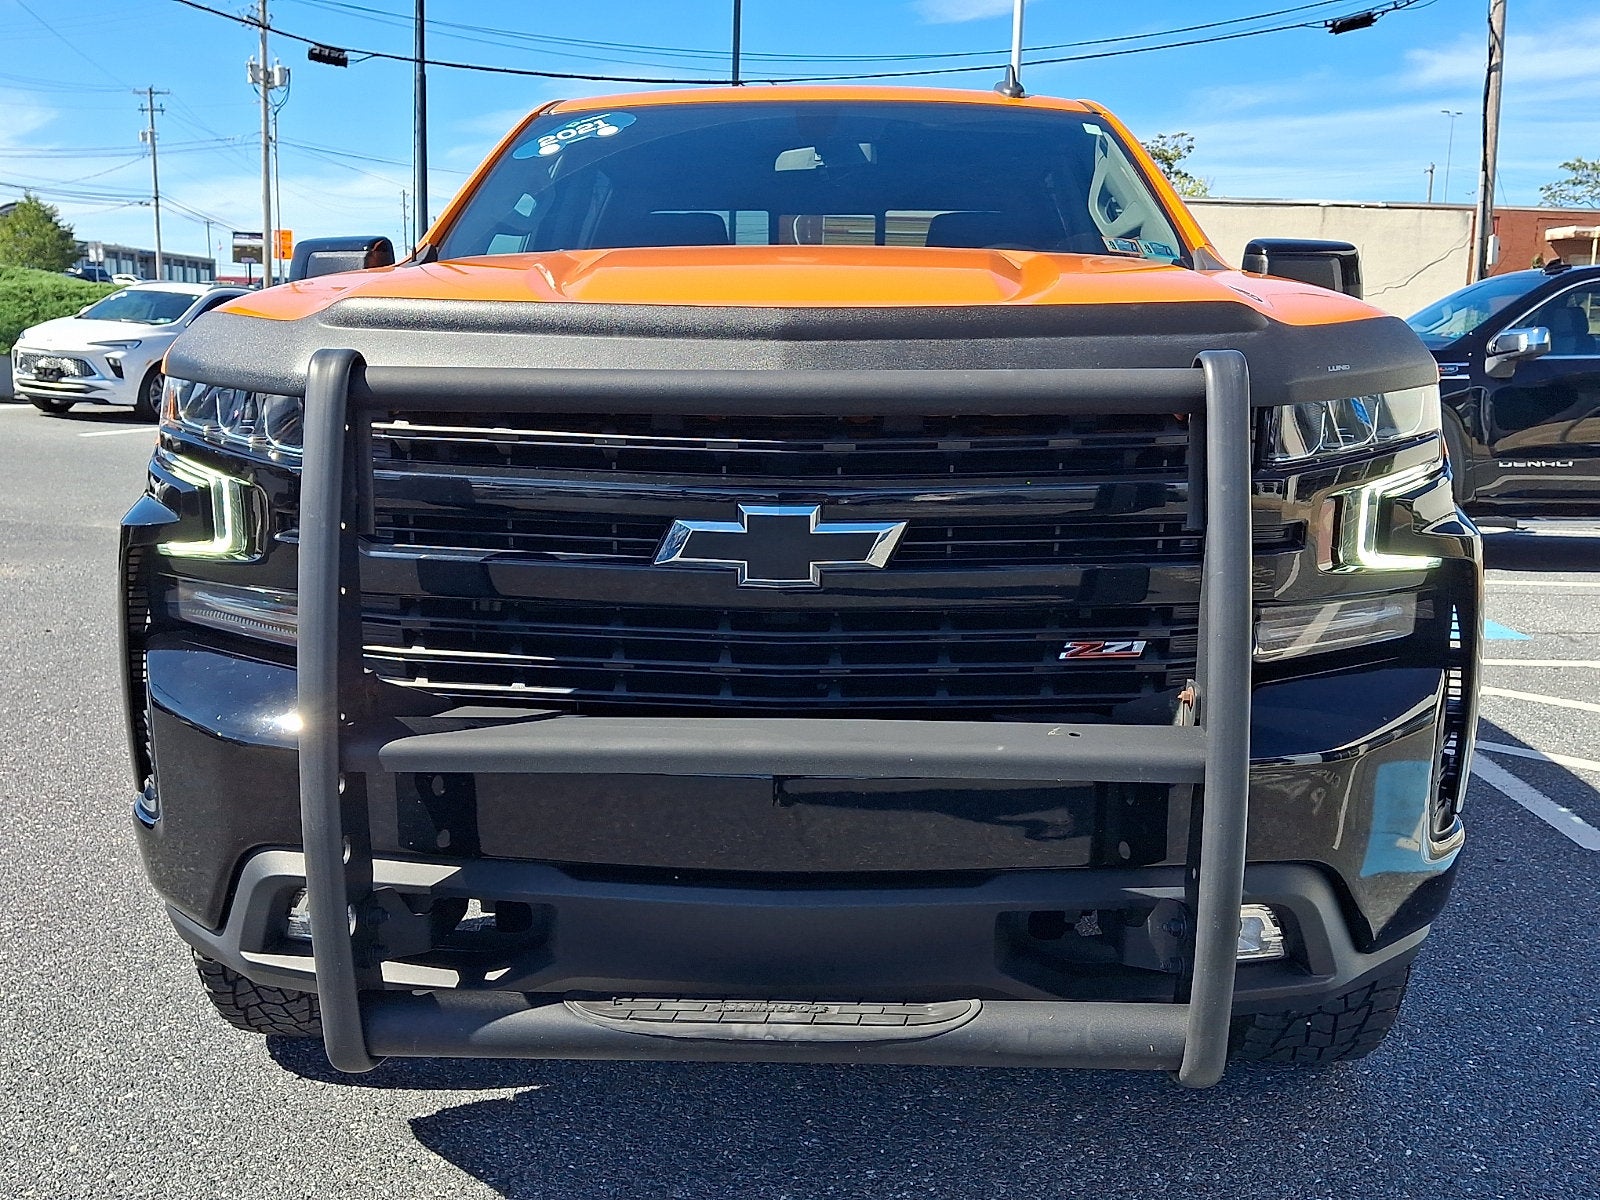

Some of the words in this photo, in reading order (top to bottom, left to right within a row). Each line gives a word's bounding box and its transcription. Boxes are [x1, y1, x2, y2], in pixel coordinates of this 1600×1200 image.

[538, 119, 610, 146] 2021
[1327, 364, 1351, 372] LUND
[1498, 460, 1574, 468] DENALI
[1059, 640, 1147, 659] Z71
